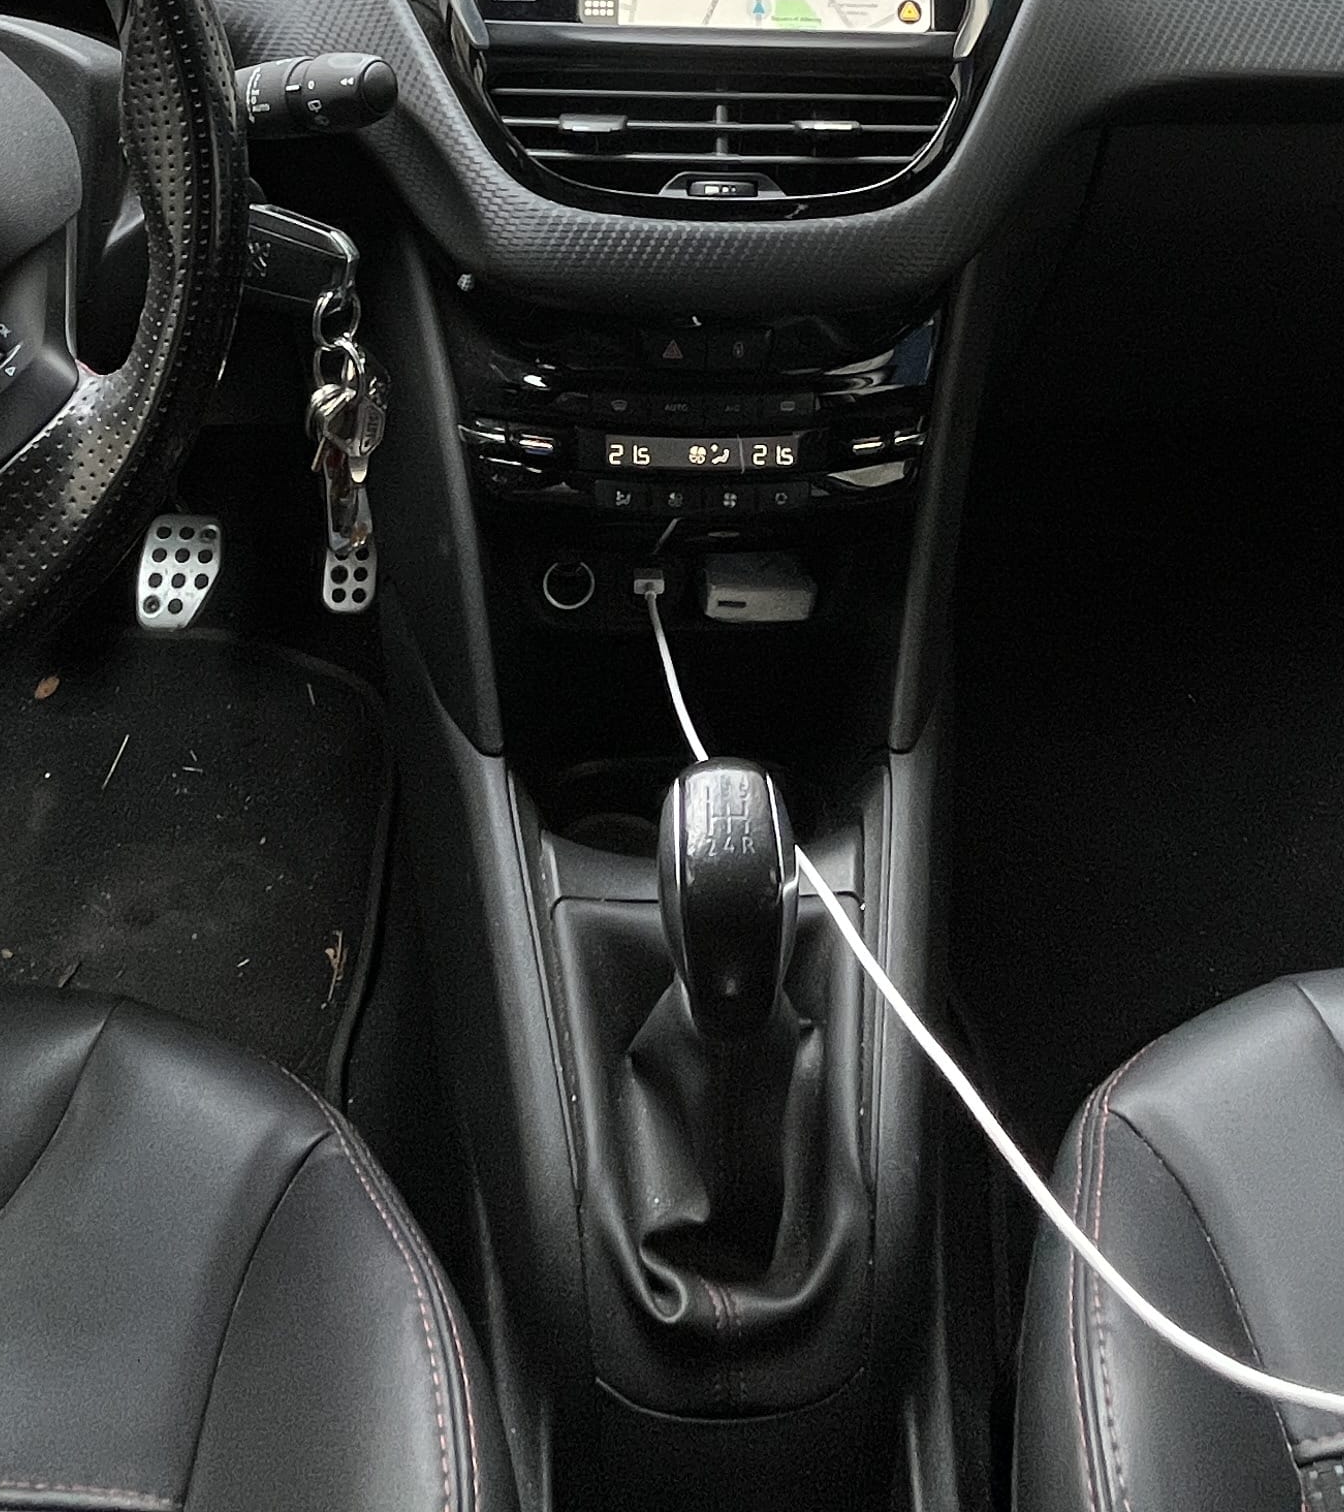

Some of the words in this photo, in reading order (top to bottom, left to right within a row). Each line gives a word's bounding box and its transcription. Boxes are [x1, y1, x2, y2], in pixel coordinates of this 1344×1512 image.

[706, 837, 717, 857] 2
[723, 835, 735, 852] 4
[742, 835, 755, 855] R
